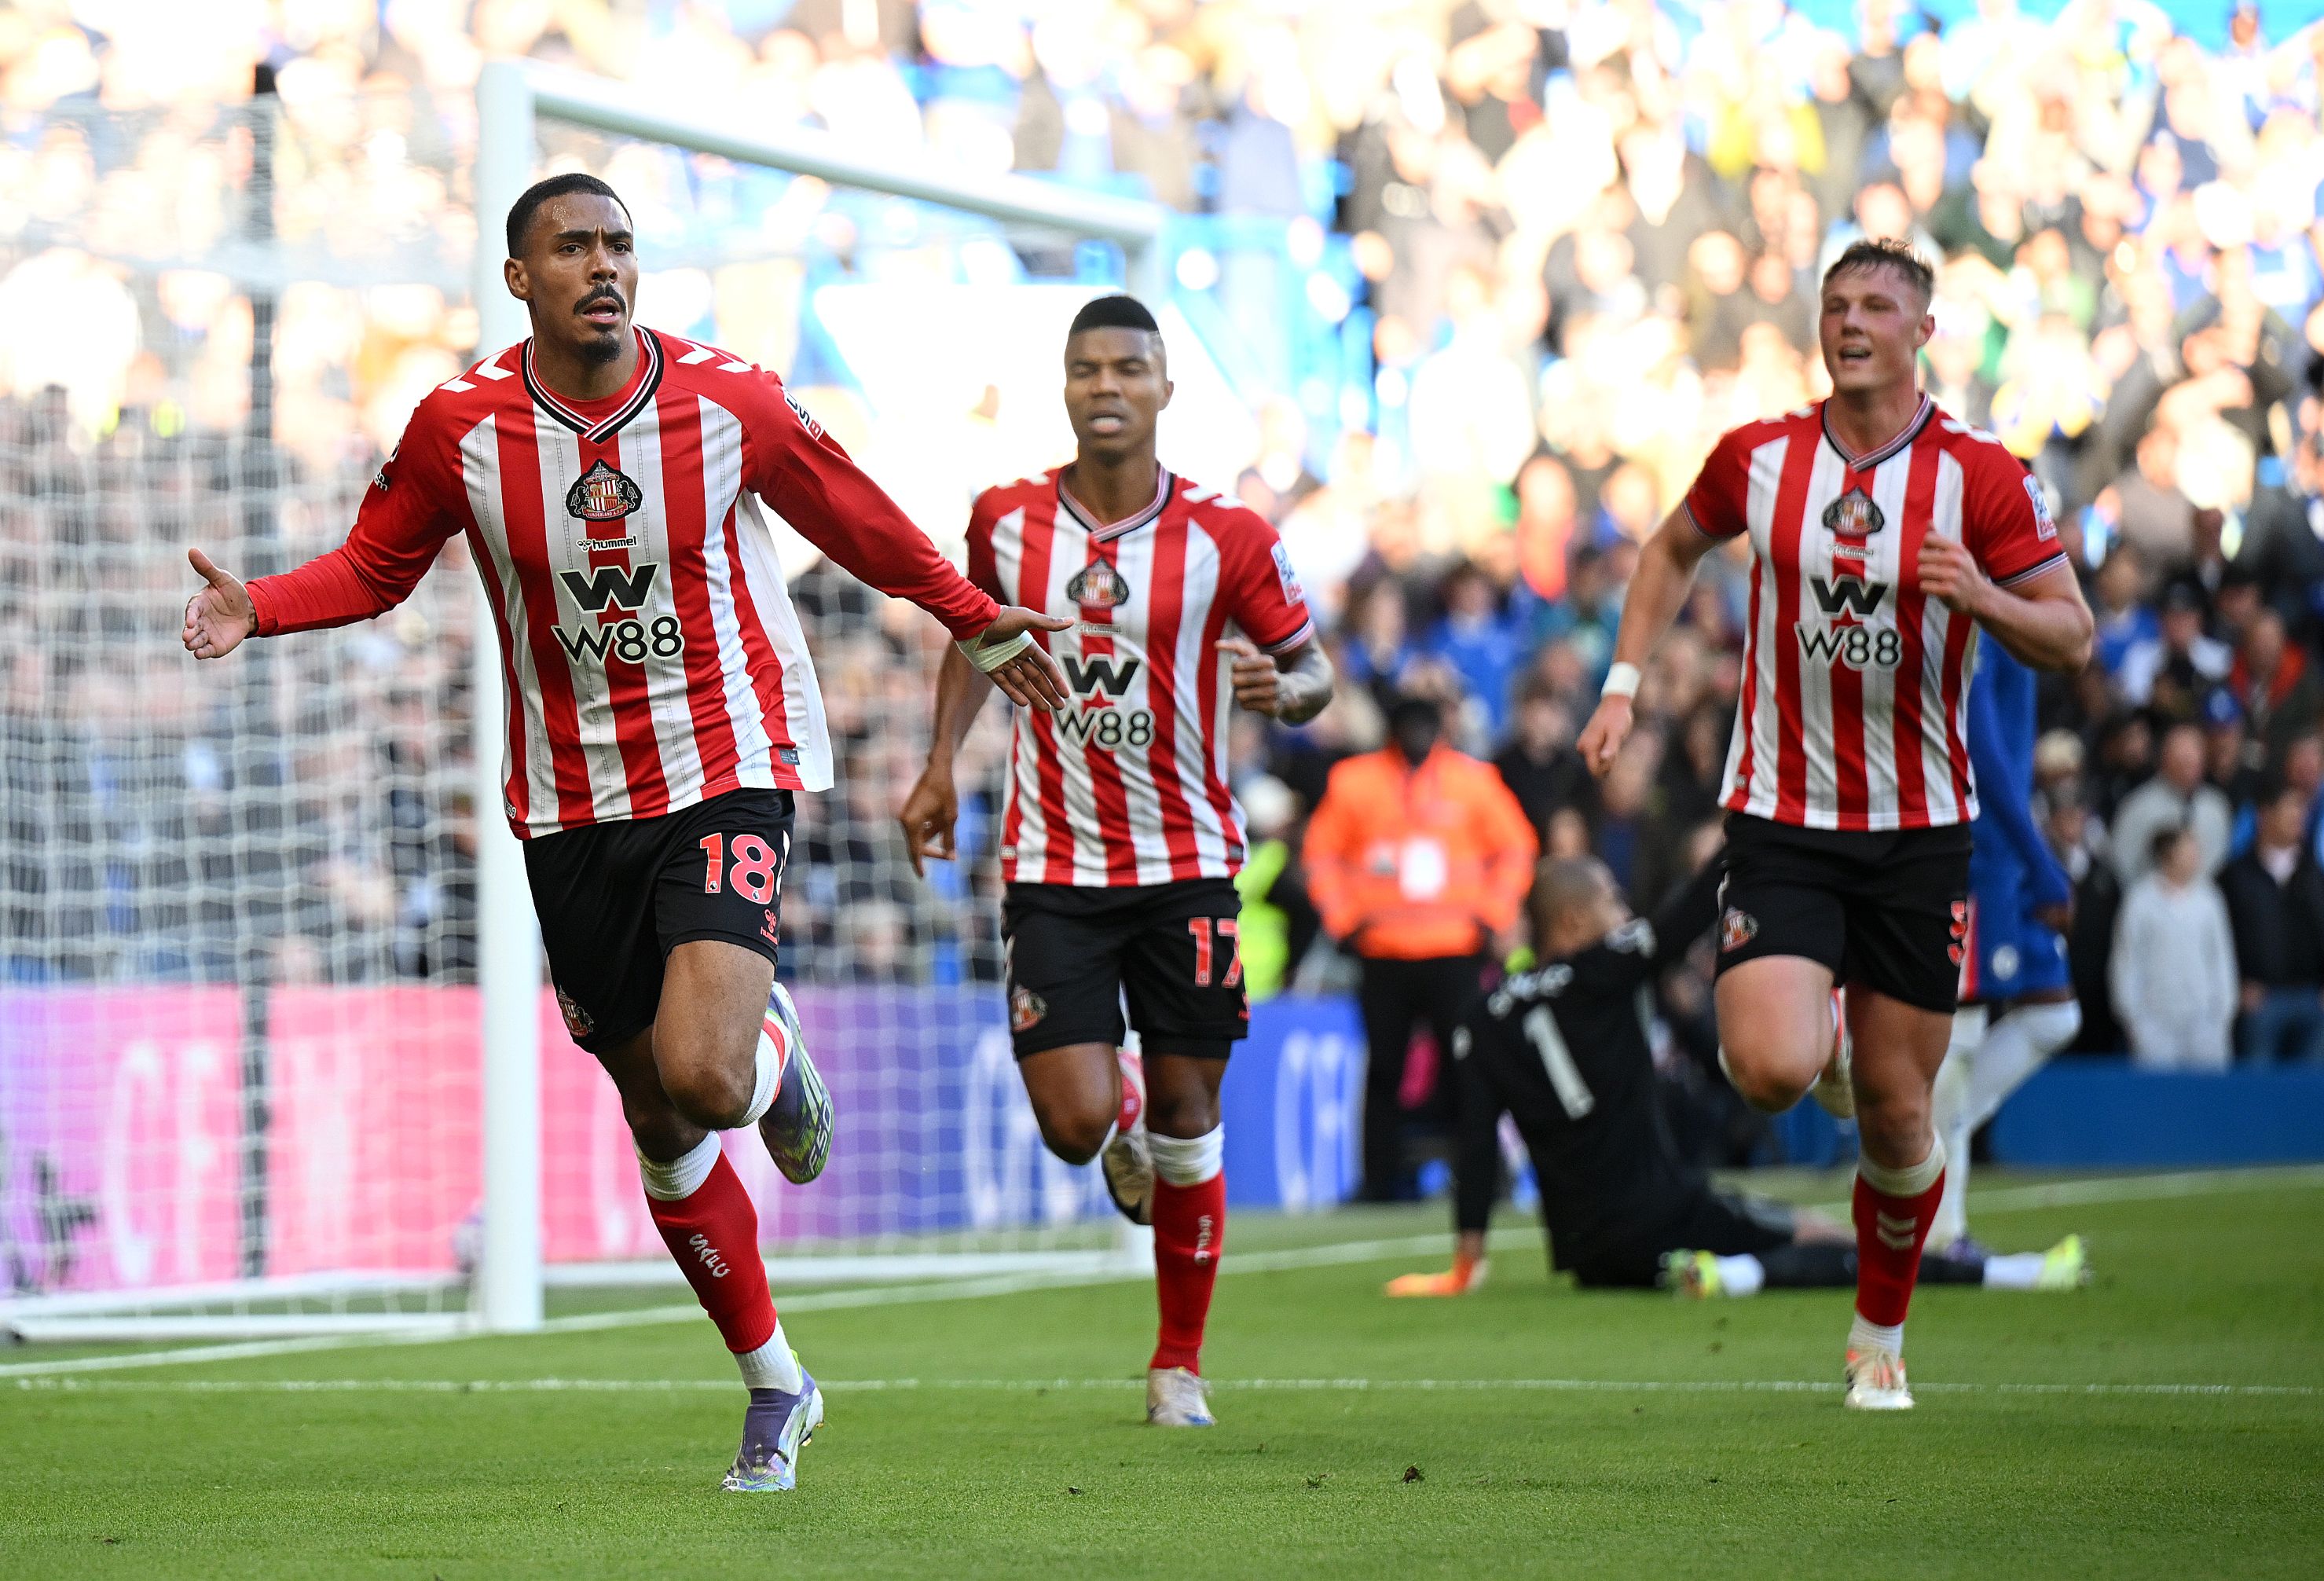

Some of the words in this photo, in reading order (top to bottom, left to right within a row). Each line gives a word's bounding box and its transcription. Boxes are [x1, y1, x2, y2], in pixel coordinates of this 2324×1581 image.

[592, 534, 637, 549] hummel
[554, 615, 683, 664] W88
[1796, 624, 1901, 666] W88
[1054, 710, 1151, 746] W88
[699, 832, 777, 904] 18
[1188, 917, 1240, 988] 17
[1523, 1003, 1595, 1121] 1
